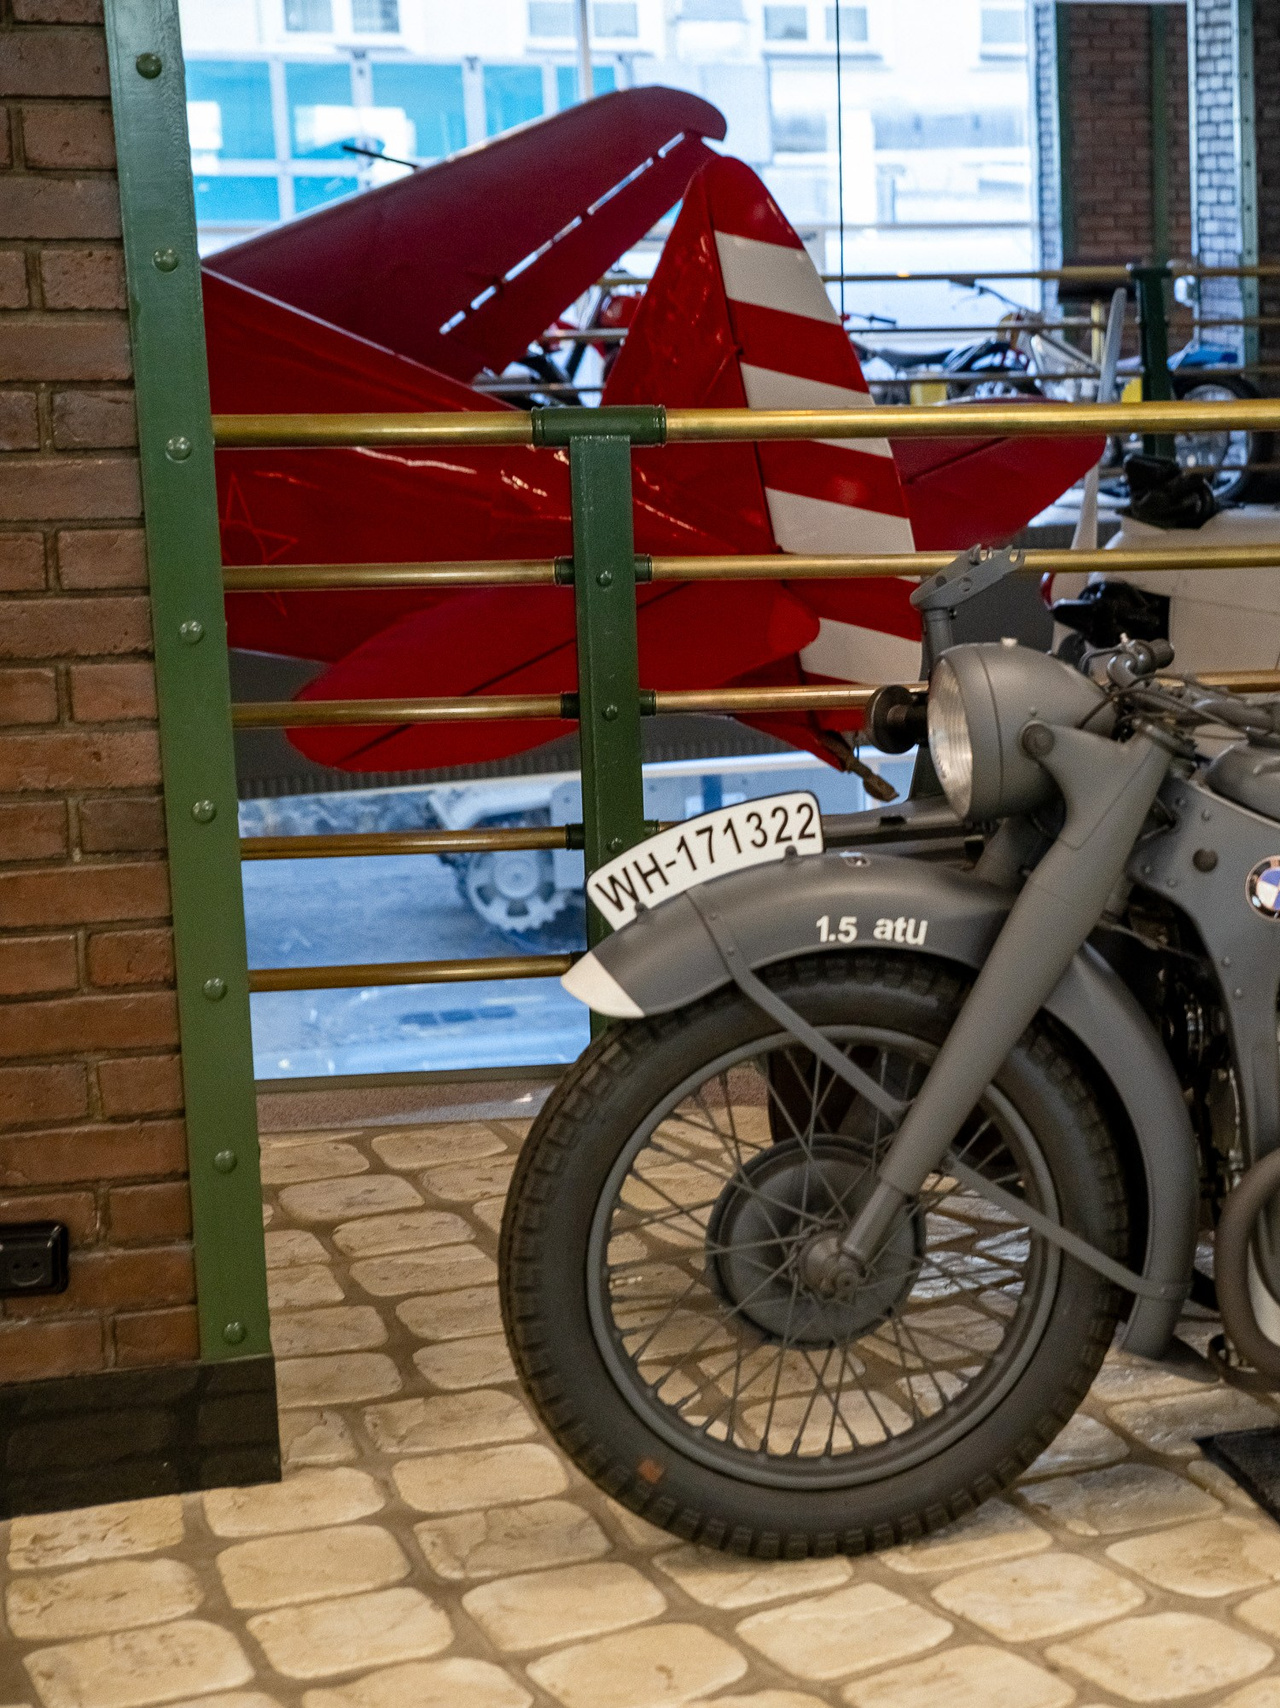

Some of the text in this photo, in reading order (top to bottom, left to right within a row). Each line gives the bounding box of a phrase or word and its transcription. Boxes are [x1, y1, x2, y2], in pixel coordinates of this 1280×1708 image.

[595, 803, 816, 912] WH-171322
[816, 915, 928, 945] 1.5 atu
